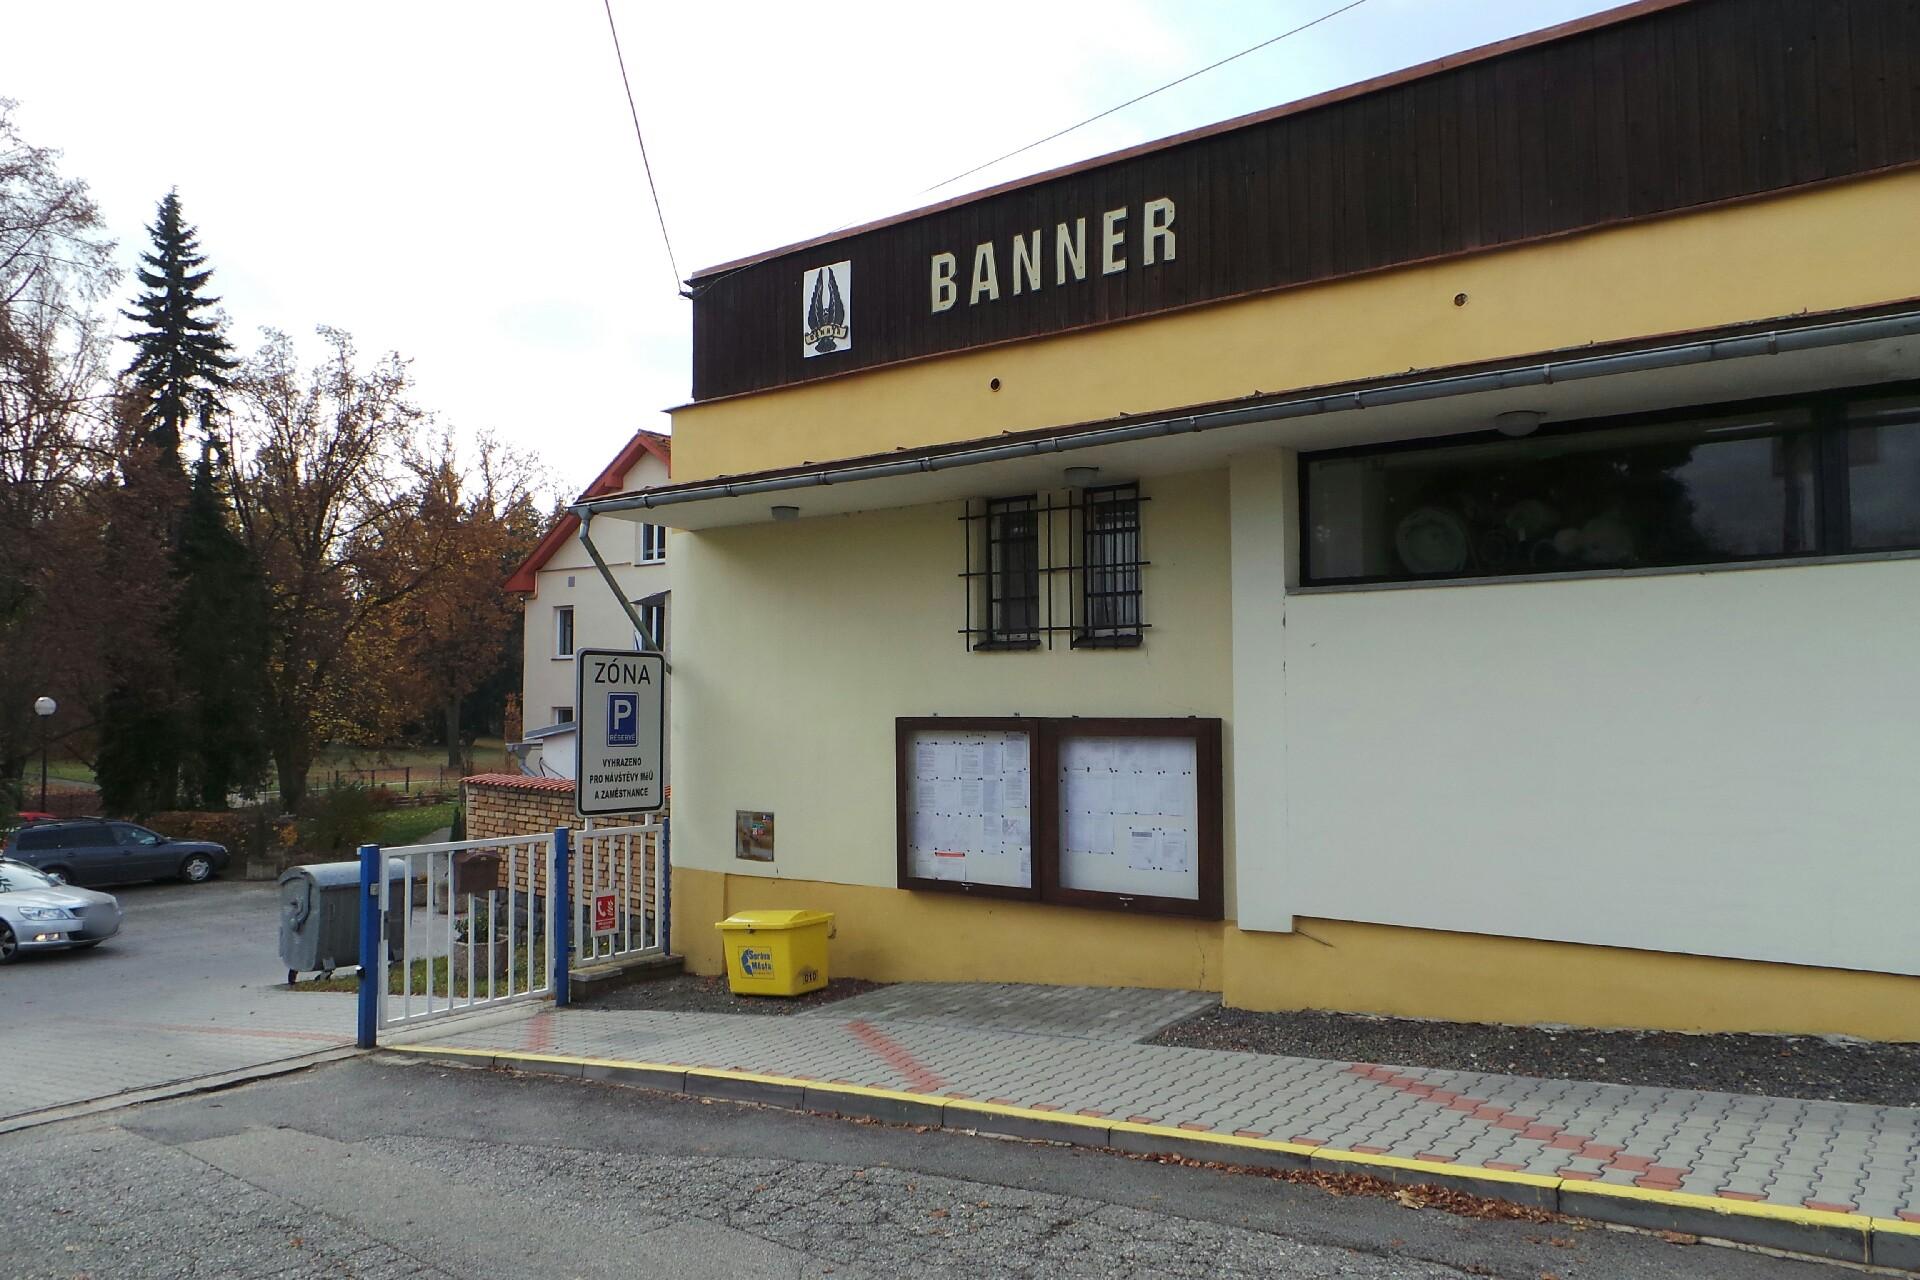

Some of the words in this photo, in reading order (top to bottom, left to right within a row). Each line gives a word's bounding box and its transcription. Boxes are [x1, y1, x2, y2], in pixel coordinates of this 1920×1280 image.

[931, 197, 1177, 313] BANNER
[595, 658, 651, 685] ZÓNA
[614, 699, 632, 730] P
[602, 757, 642, 768] VYHRAZENO
[589, 774, 603, 784] PRO
[595, 790, 599, 800] A
